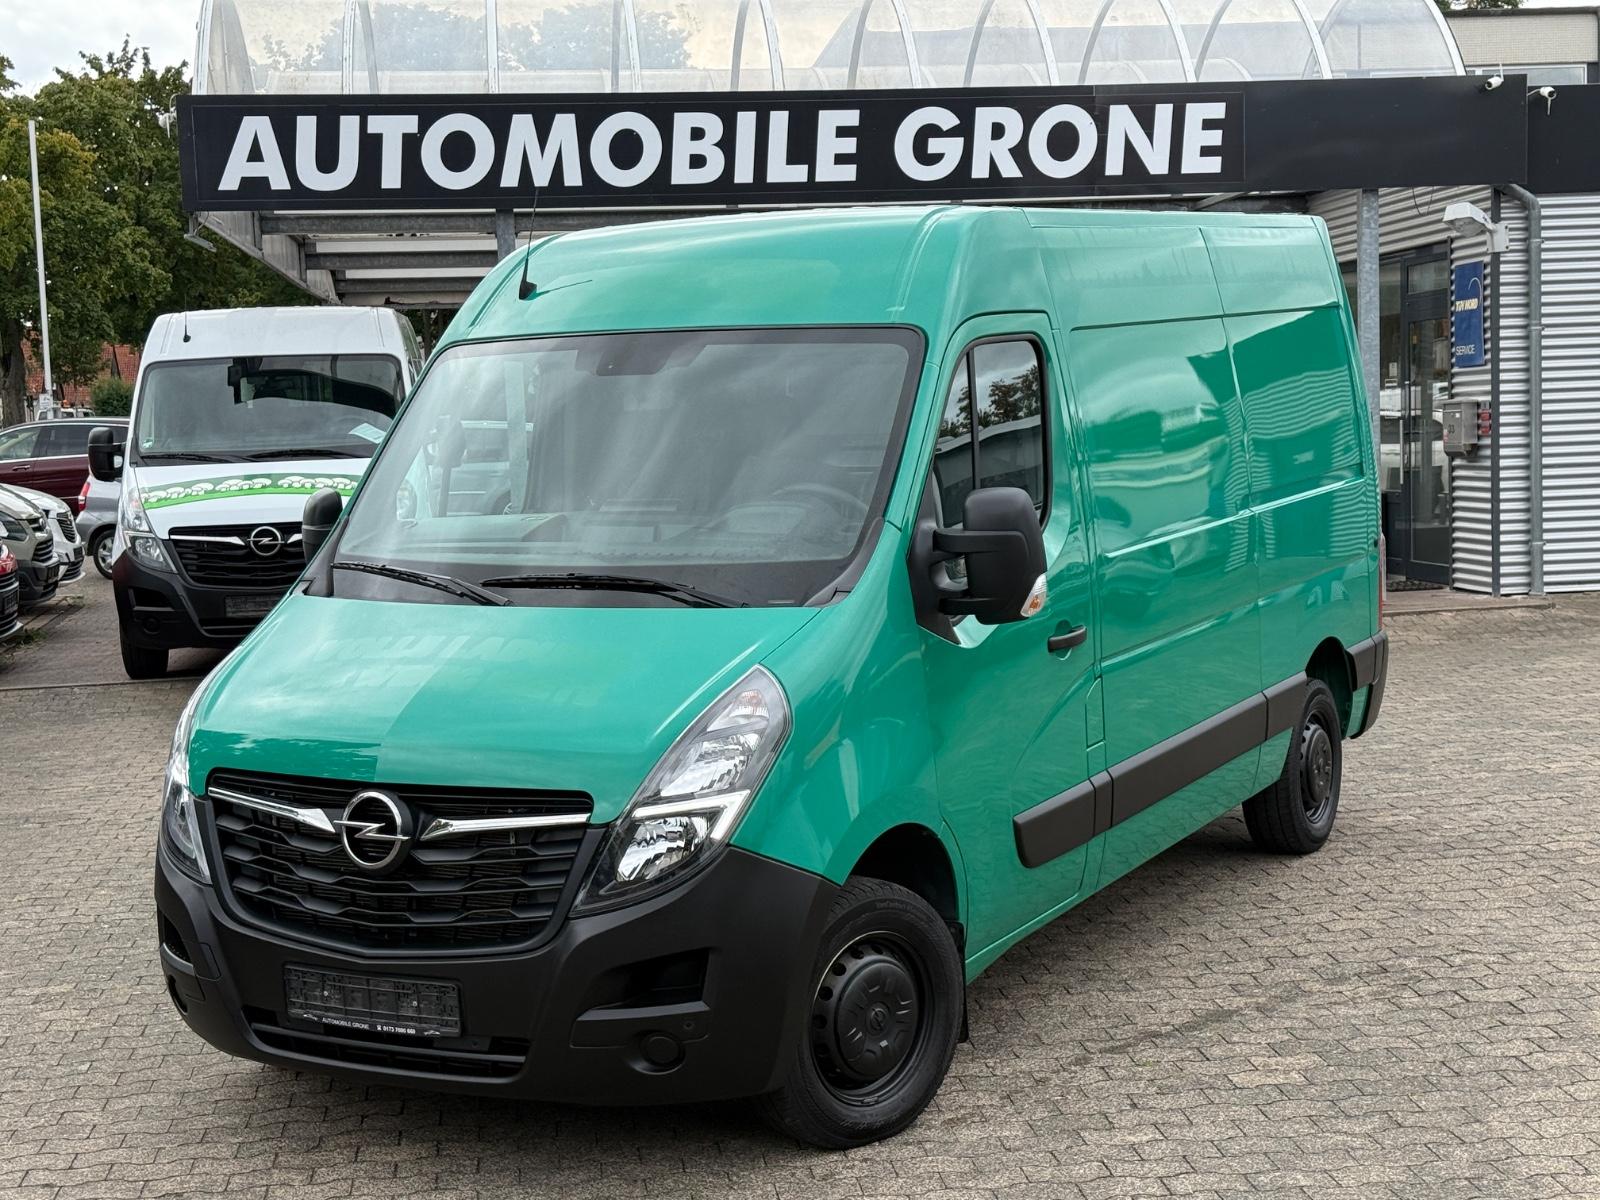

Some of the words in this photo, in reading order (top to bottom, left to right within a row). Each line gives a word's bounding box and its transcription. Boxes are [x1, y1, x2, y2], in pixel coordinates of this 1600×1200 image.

[217, 111, 861, 191] AUTOMOBILE
[894, 101, 1227, 182] GRONE
[1456, 344, 1475, 356] SERVICE
